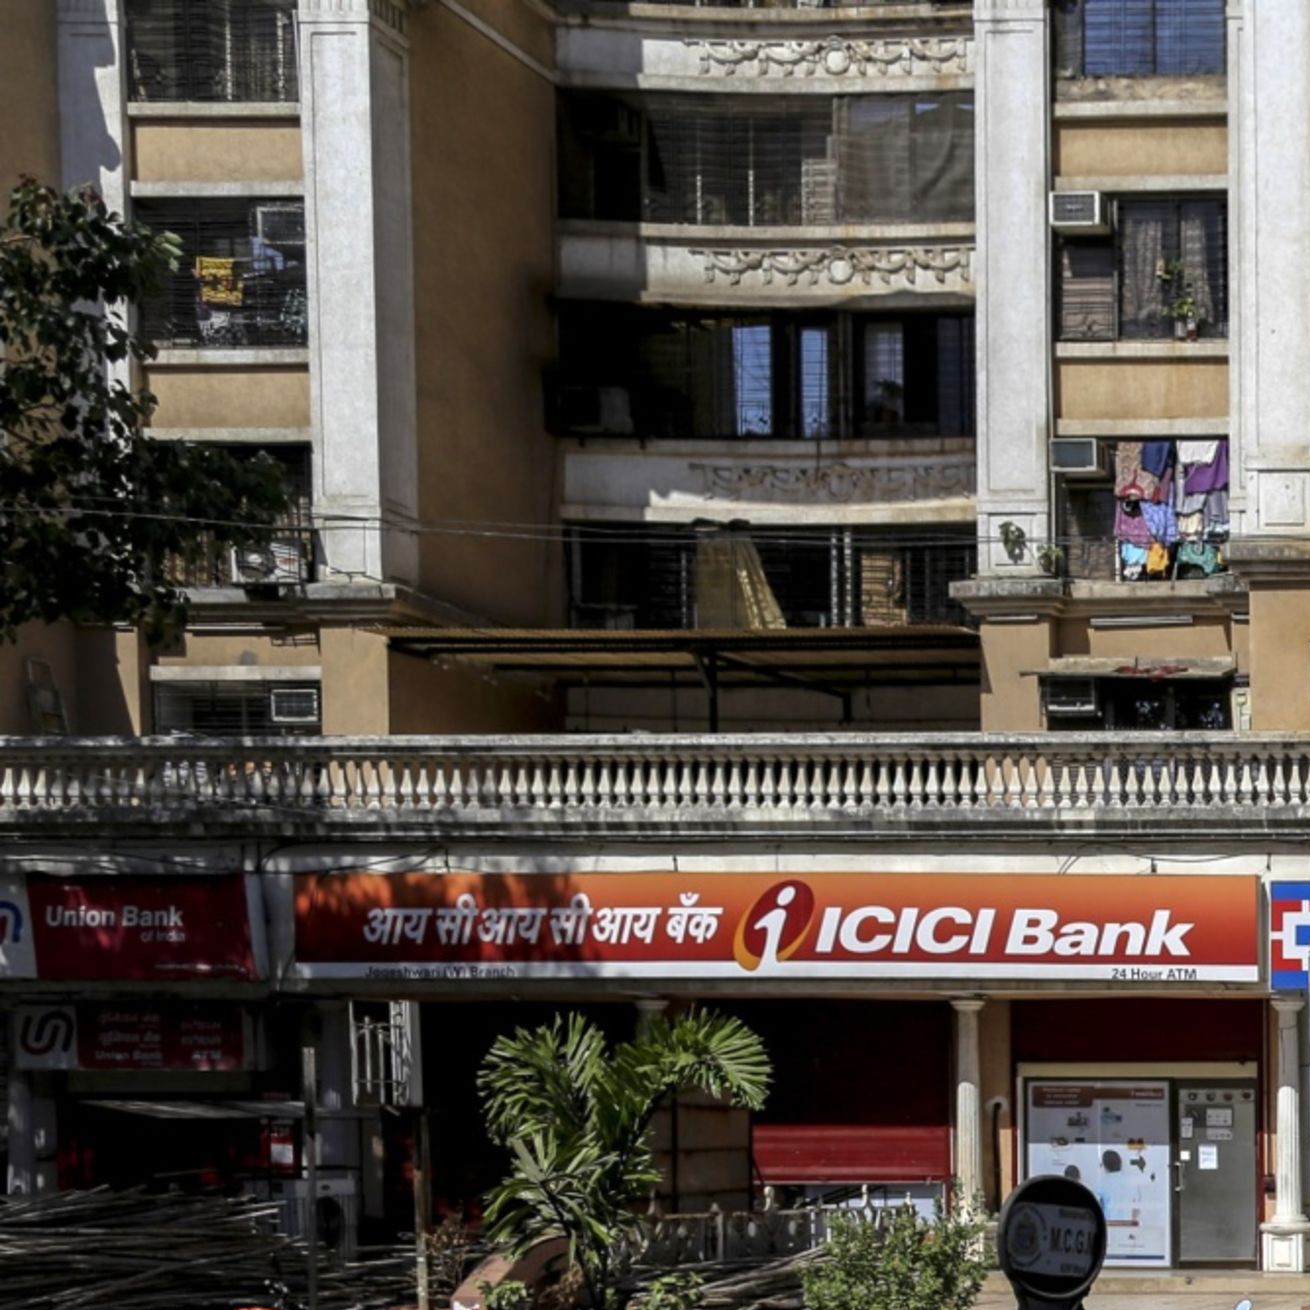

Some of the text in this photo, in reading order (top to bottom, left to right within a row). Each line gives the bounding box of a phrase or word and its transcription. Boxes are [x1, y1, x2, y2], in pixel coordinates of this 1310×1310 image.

[45, 905, 183, 927] Union Bank
[435, 893, 478, 945] सी
[550, 892, 593, 945] सी
[592, 906, 662, 945] आय
[666, 891, 723, 945] बँक
[815, 905, 1196, 957] ICICI Bank
[470, 965, 516, 978] Branch
[1111, 967, 1198, 981] 24 Hour ATM
